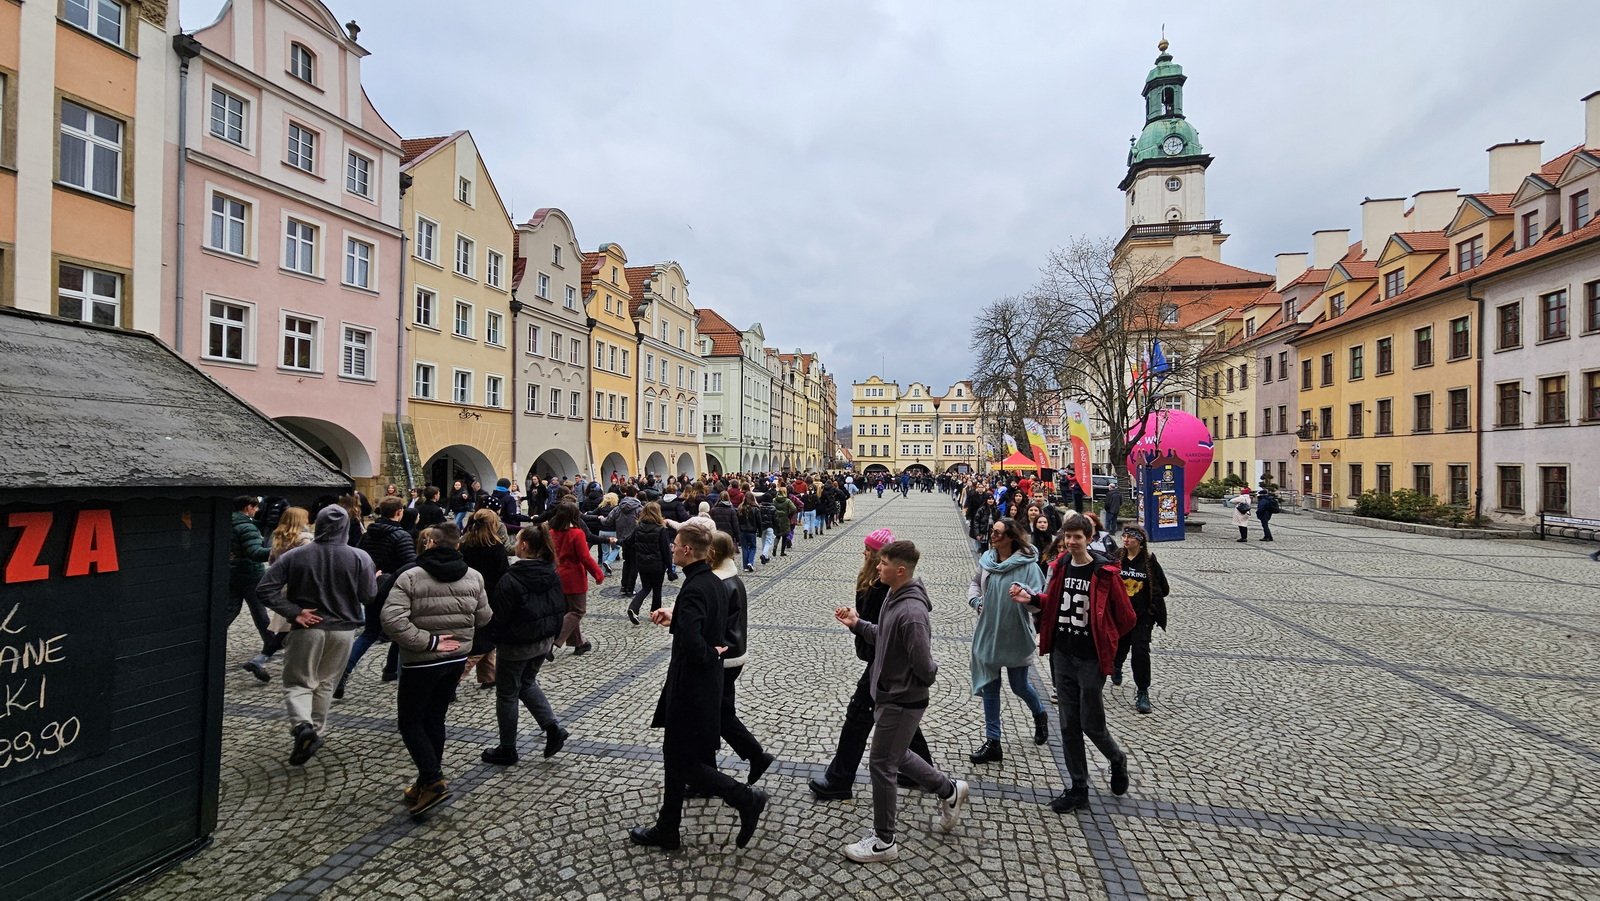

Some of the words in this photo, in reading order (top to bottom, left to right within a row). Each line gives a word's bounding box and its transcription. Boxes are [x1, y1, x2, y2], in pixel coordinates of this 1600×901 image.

[5, 509, 119, 584] ZA
[1058, 591, 1090, 628] 23
[0, 673, 46, 719] KI
